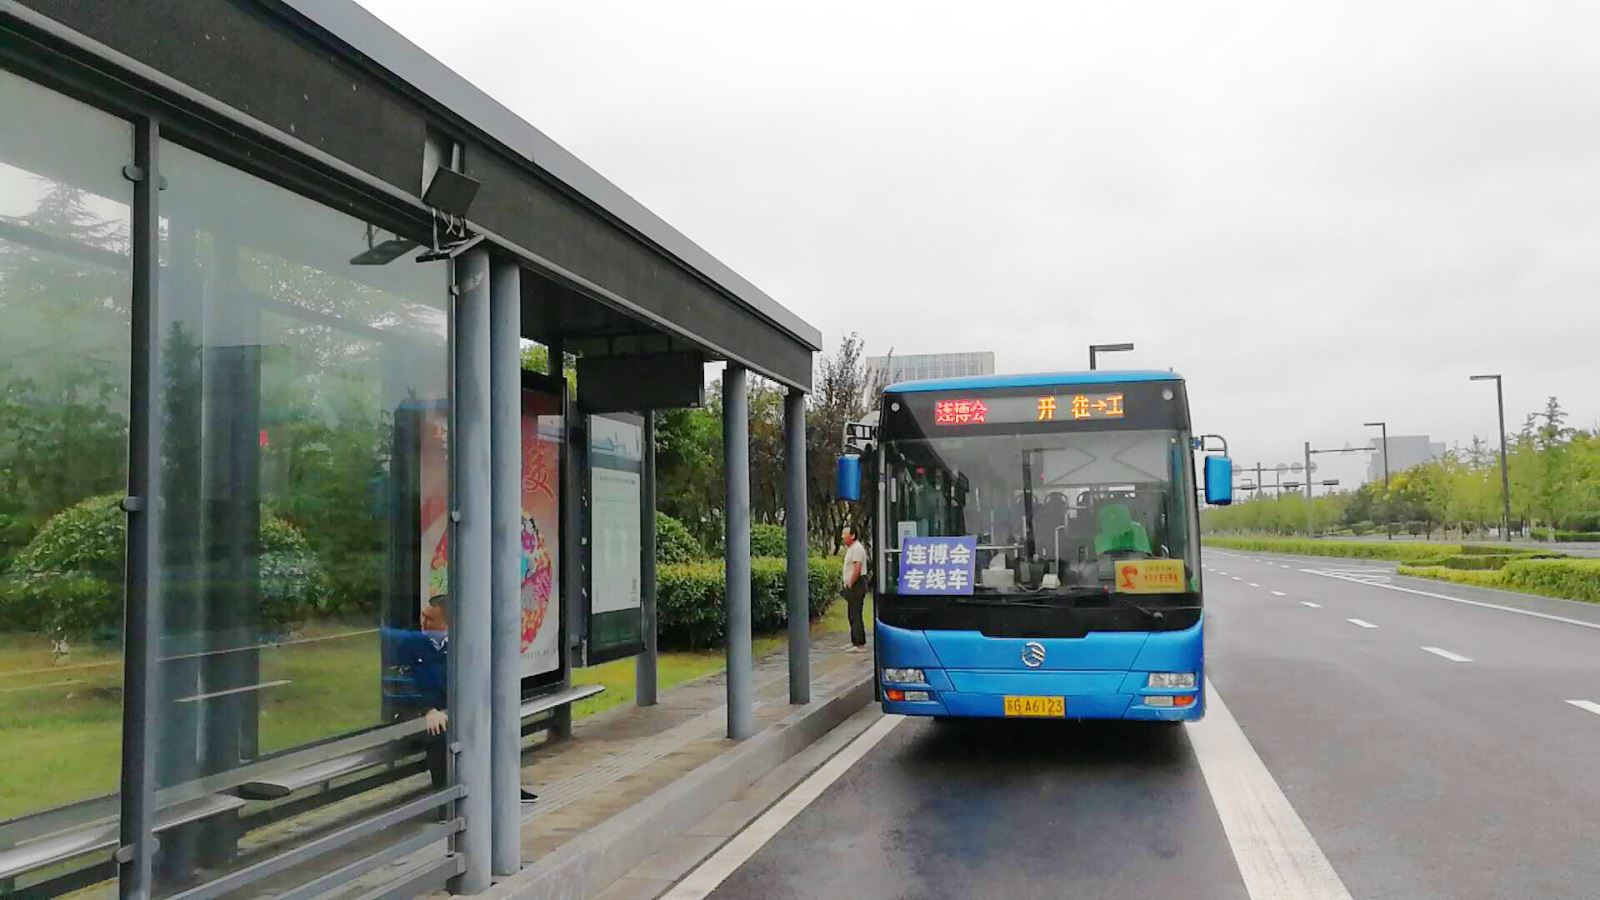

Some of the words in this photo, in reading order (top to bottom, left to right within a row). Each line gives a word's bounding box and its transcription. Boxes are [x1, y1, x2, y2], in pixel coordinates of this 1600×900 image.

[906, 543, 971, 565] 连博会
[903, 568, 969, 590] 专线车
